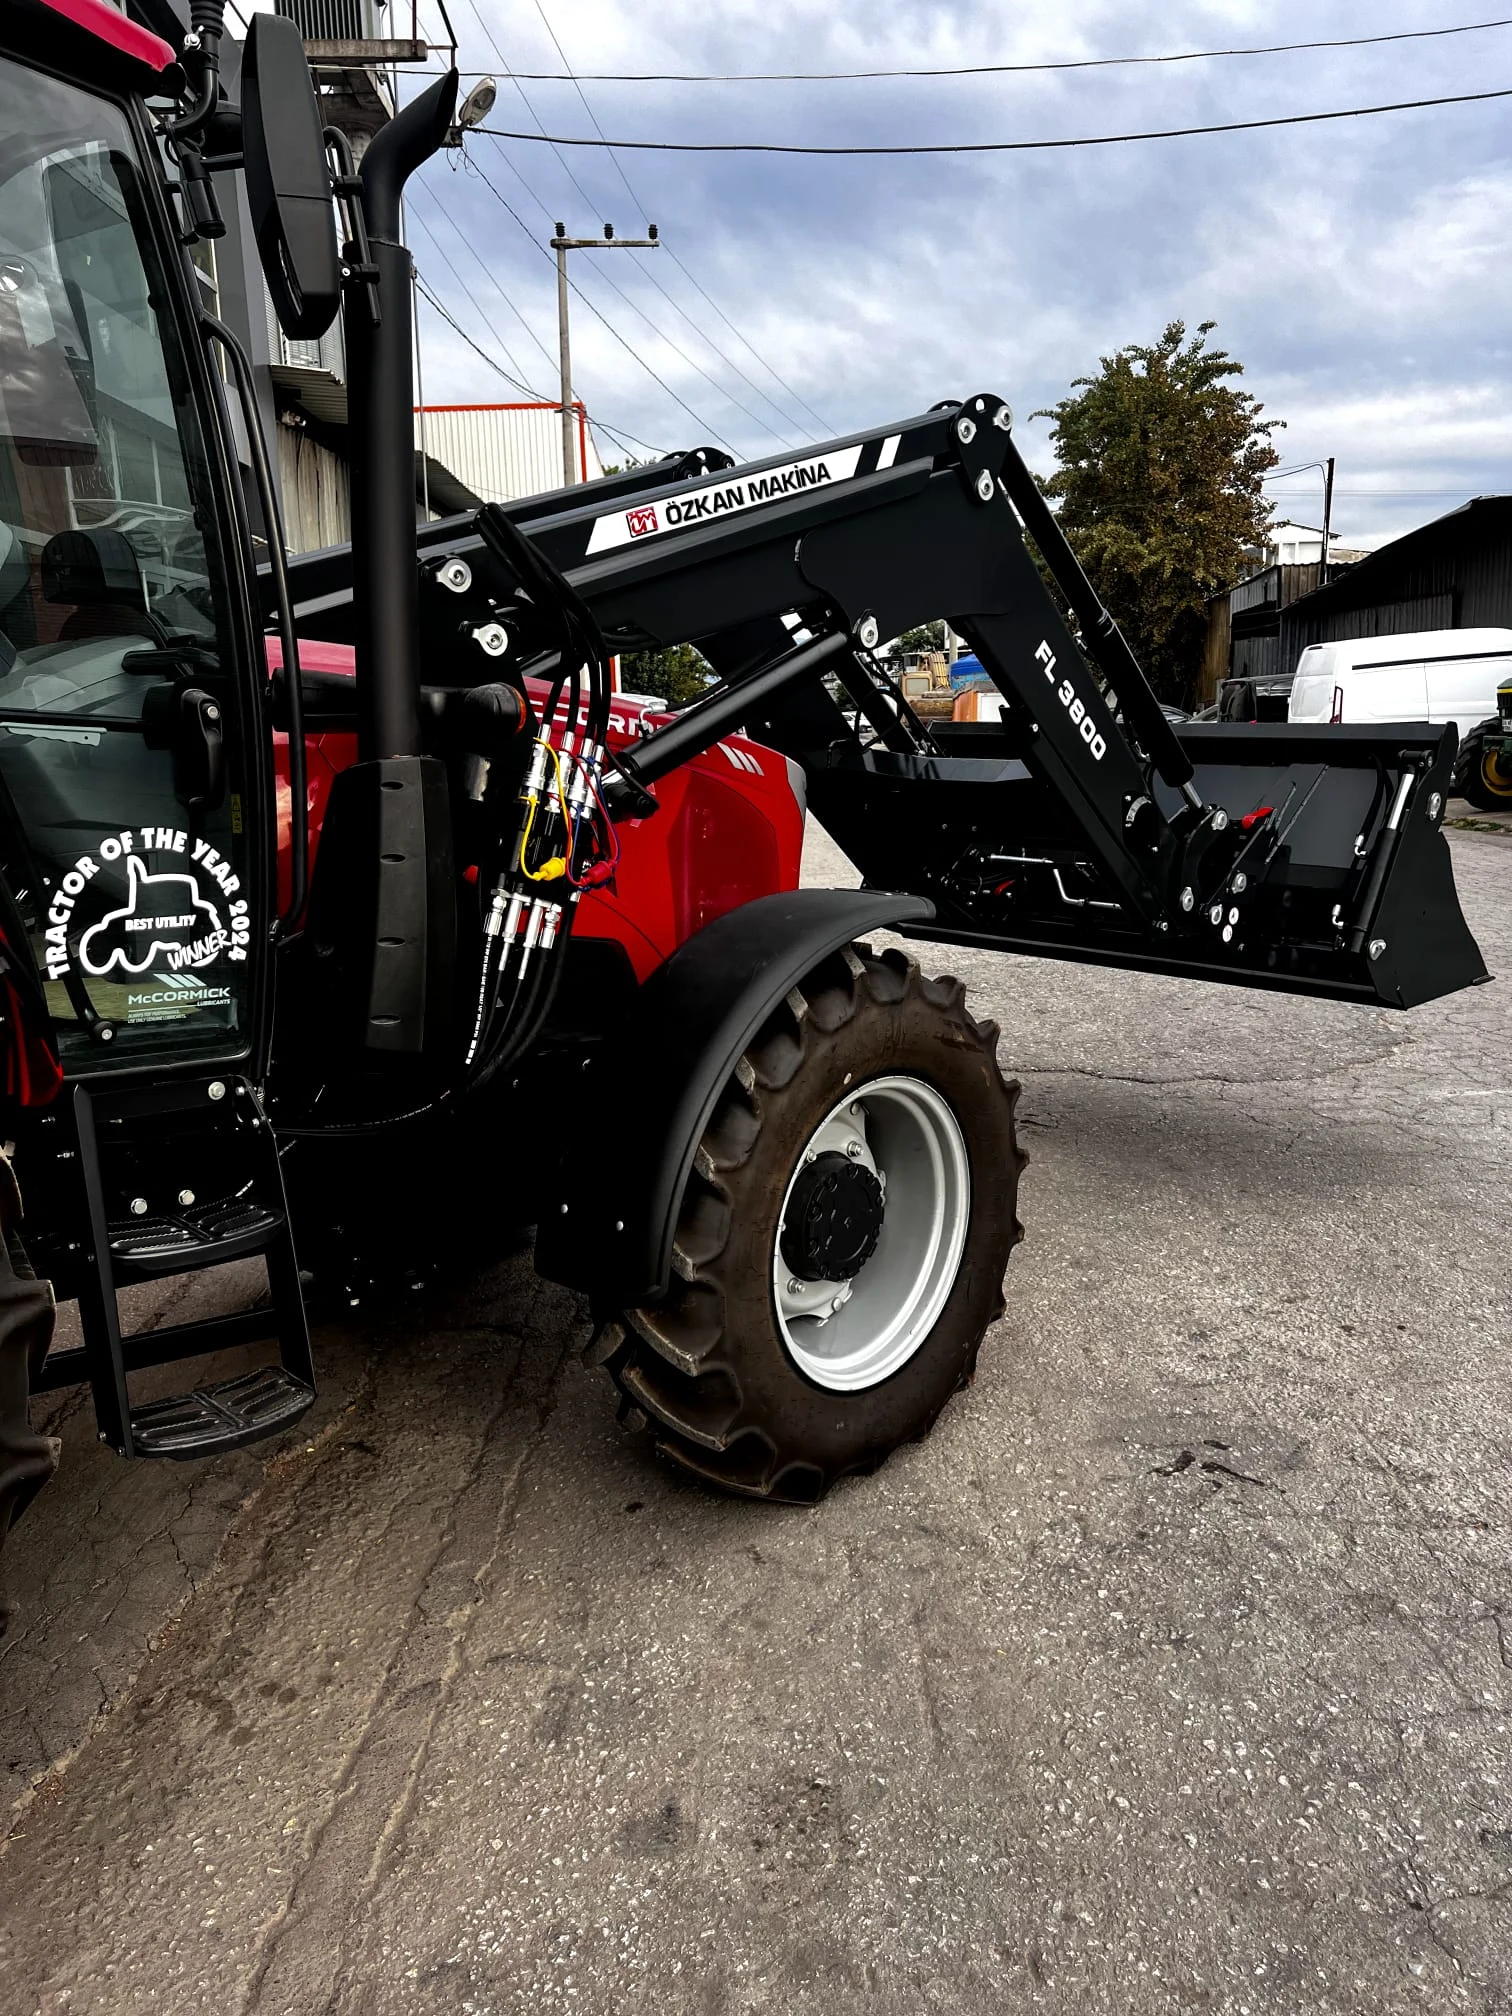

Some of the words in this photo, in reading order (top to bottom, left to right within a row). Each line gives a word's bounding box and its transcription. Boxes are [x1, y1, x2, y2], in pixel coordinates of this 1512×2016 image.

[665, 485, 744, 525] ÖZKAN
[749, 462, 831, 503] MAKİNA
[1034, 639, 1057, 684] FL
[1058, 679, 1107, 761] 3800
[45, 854, 100, 980] TRACTOR
[100, 831, 133, 860] OF
[141, 827, 188, 852] THE
[190, 839, 241, 896] YEAR
[228, 899, 250, 961] 2024
[125, 917, 154, 931] BEST
[155, 915, 197, 929] UTILITY
[167, 931, 232, 970] WINNER
[127, 986, 231, 1006] McCORMICK
[197, 998, 231, 1007] LUBRICANTS
